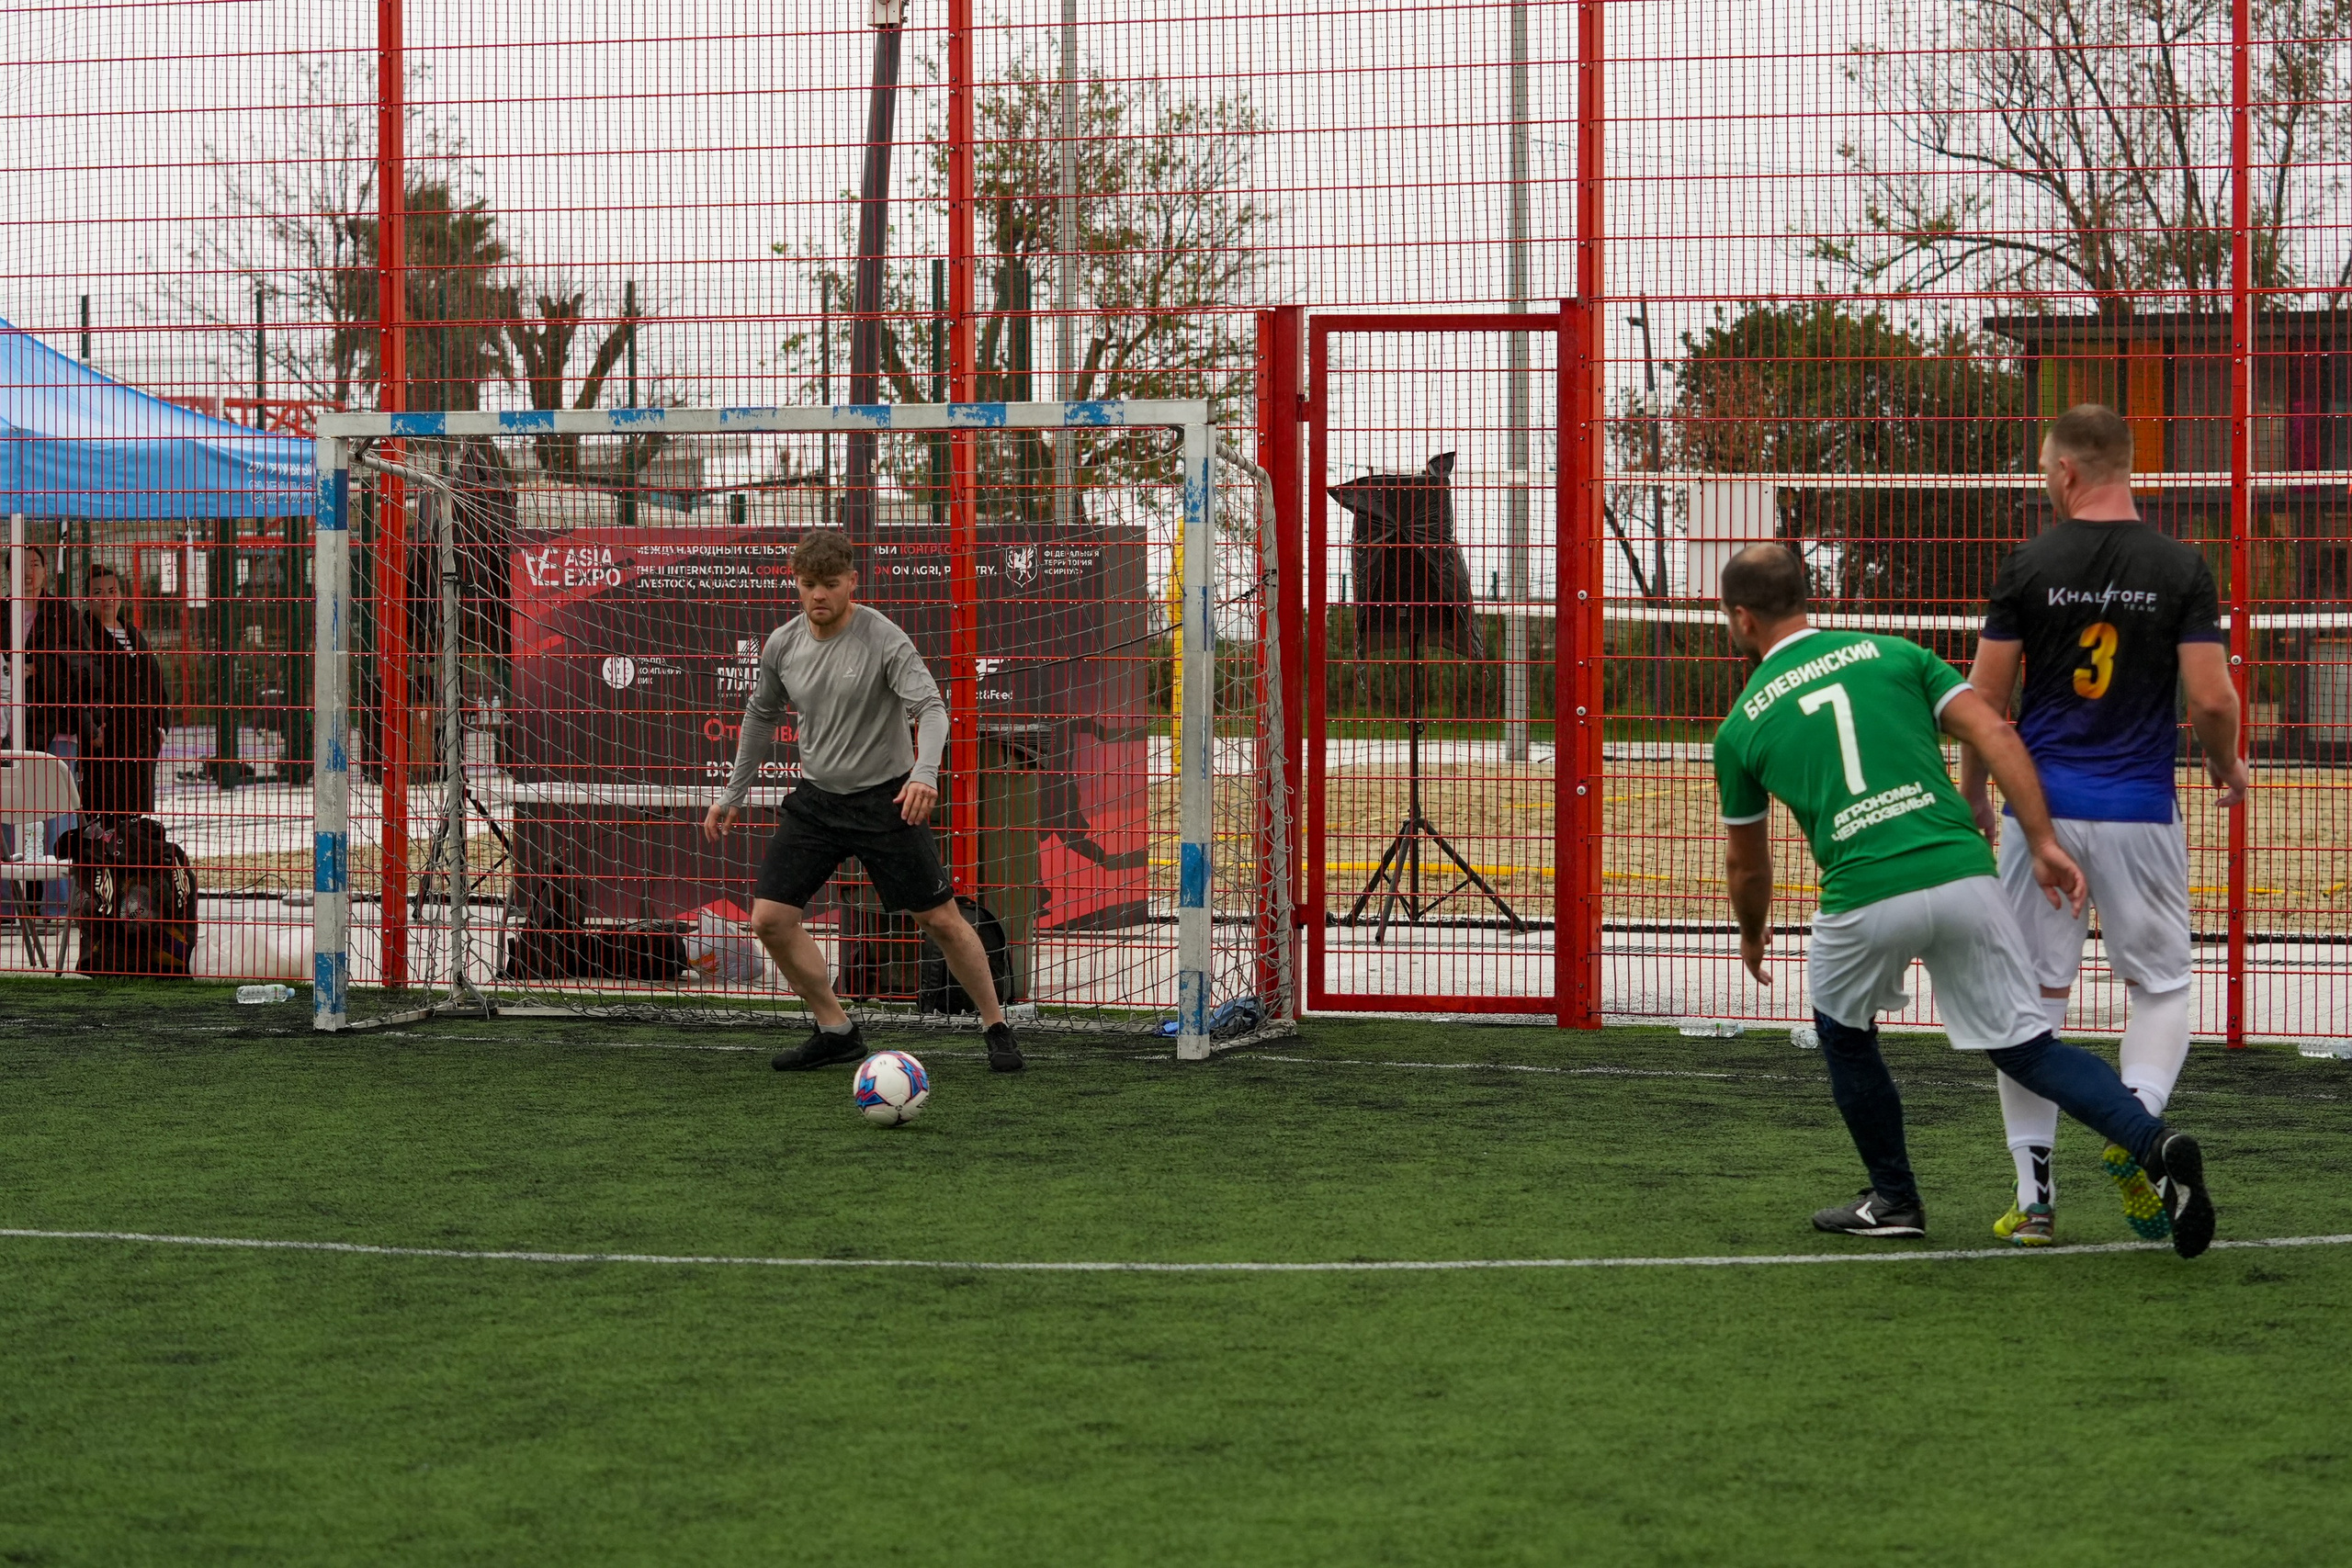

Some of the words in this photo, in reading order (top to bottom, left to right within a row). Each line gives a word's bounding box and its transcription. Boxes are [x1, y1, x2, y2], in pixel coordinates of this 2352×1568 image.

[564, 548, 613, 568] ASIA
[636, 566, 655, 575] THE
[667, 566, 753, 575] INTERNATIONAL
[892, 566, 910, 575] ON
[564, 568, 622, 587] EXPO
[636, 579, 696, 590] LIVESTOCK,
[699, 579, 778, 591] AQUACULTURE
[2123, 603, 2156, 613] TEAM
[2073, 622, 2119, 700] 3
[1743, 639, 1881, 721] БЕЛЕВИНСКИЙ
[1798, 682, 1868, 795] 7
[1831, 792, 1936, 841] ЧЕРНОЗЕМЬЯ
[1834, 781, 1923, 829] АГРОНОМЫ
